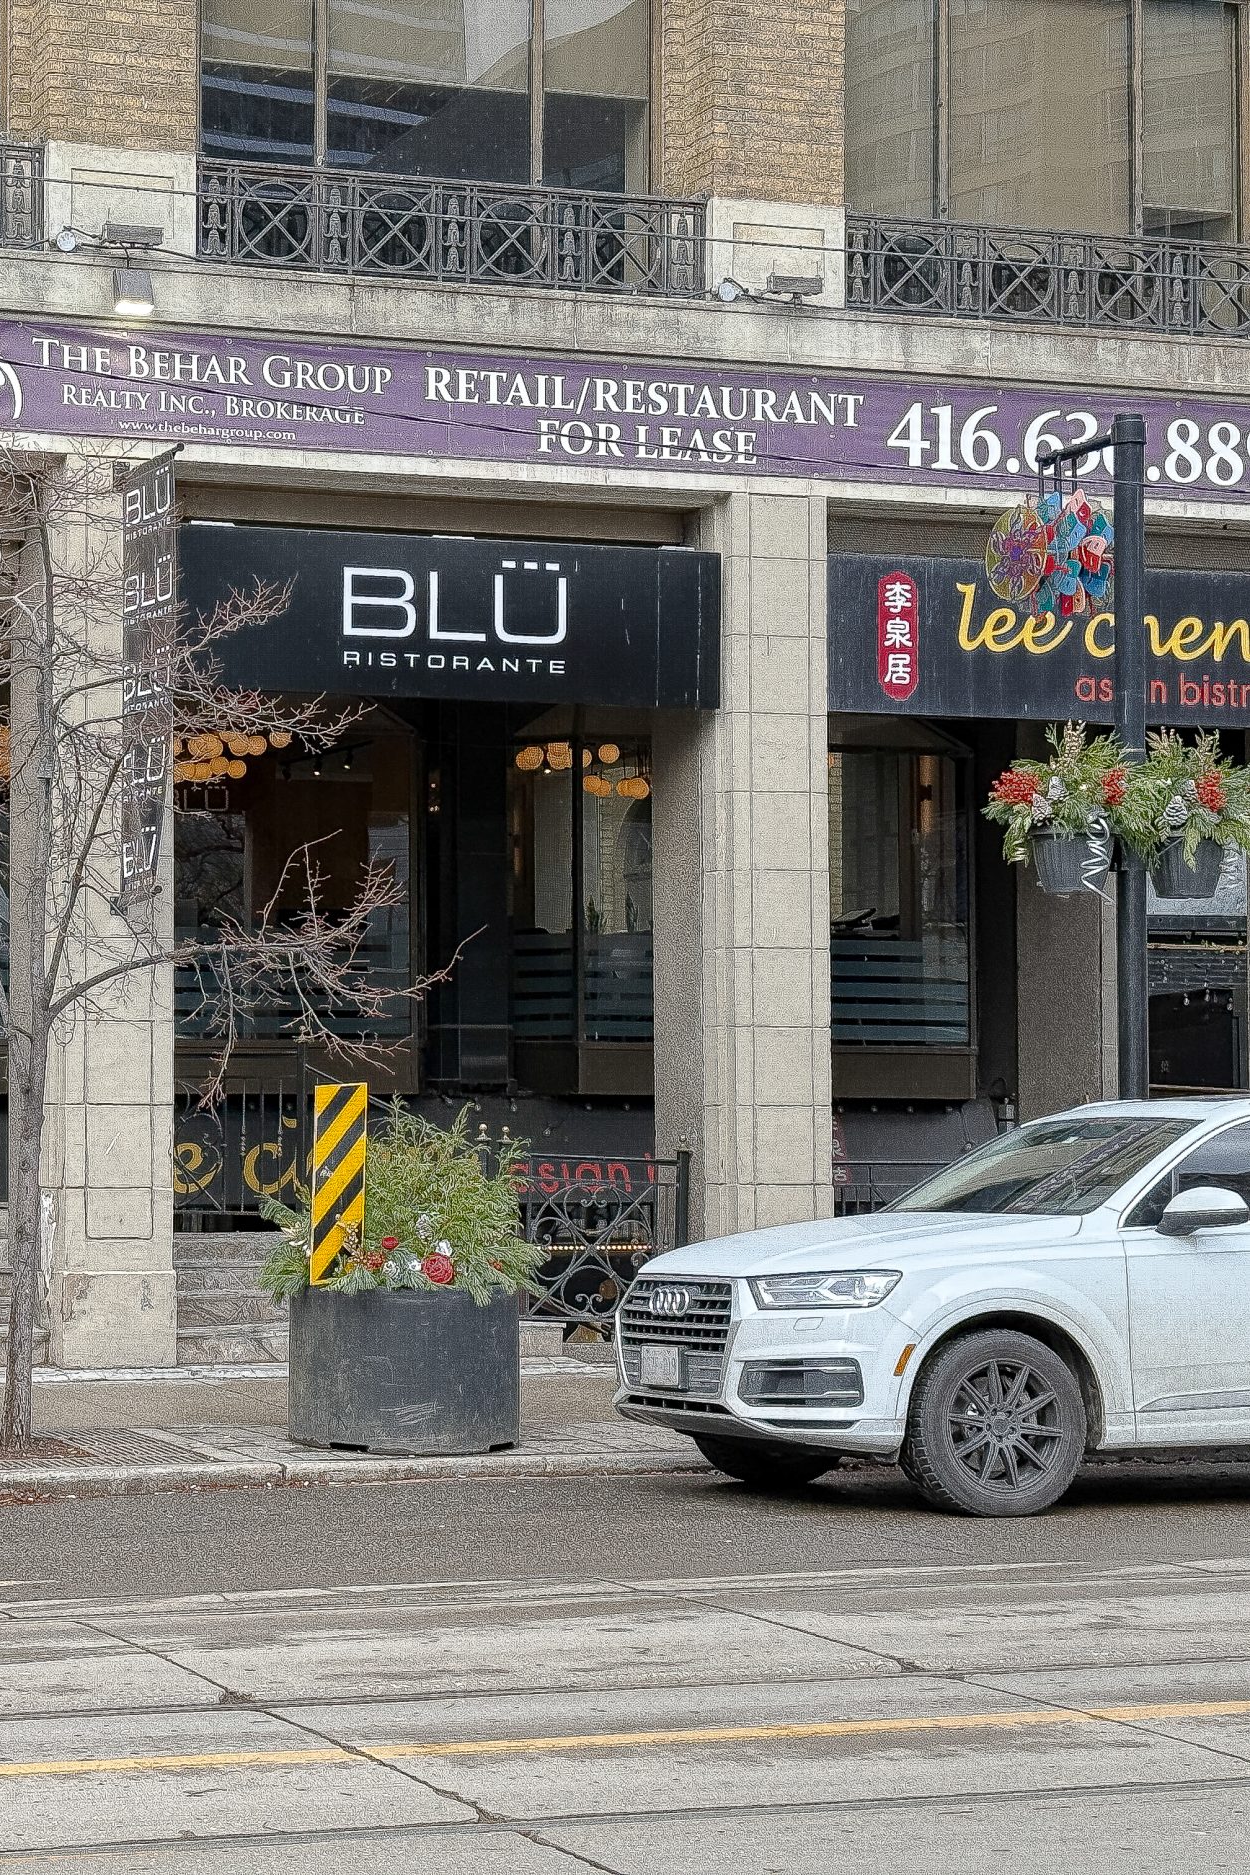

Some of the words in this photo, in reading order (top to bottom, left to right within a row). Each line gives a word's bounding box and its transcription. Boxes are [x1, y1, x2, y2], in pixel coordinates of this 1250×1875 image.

[32, 337, 112, 376] THE
[127, 346, 254, 387] BEHAR
[262, 356, 392, 395] GROUP
[62, 383, 151, 411] REALTY
[158, 391, 216, 417] INC.,
[225, 395, 366, 425] BROKERAGE
[424, 366, 865, 427] RETAIL/RESTAURANT
[118, 420, 297, 441] www.thebehargroup.com
[537, 419, 625, 458] FOR
[634, 424, 758, 464] LEASE
[886, 402, 1250, 486] 416.63.88
[343, 560, 567, 645] BLÜ
[955, 582, 1075, 655] lee
[884, 581, 913, 685] 李泉居
[344, 651, 566, 674] RISTORANTE
[1075, 676, 1168, 705] asn
